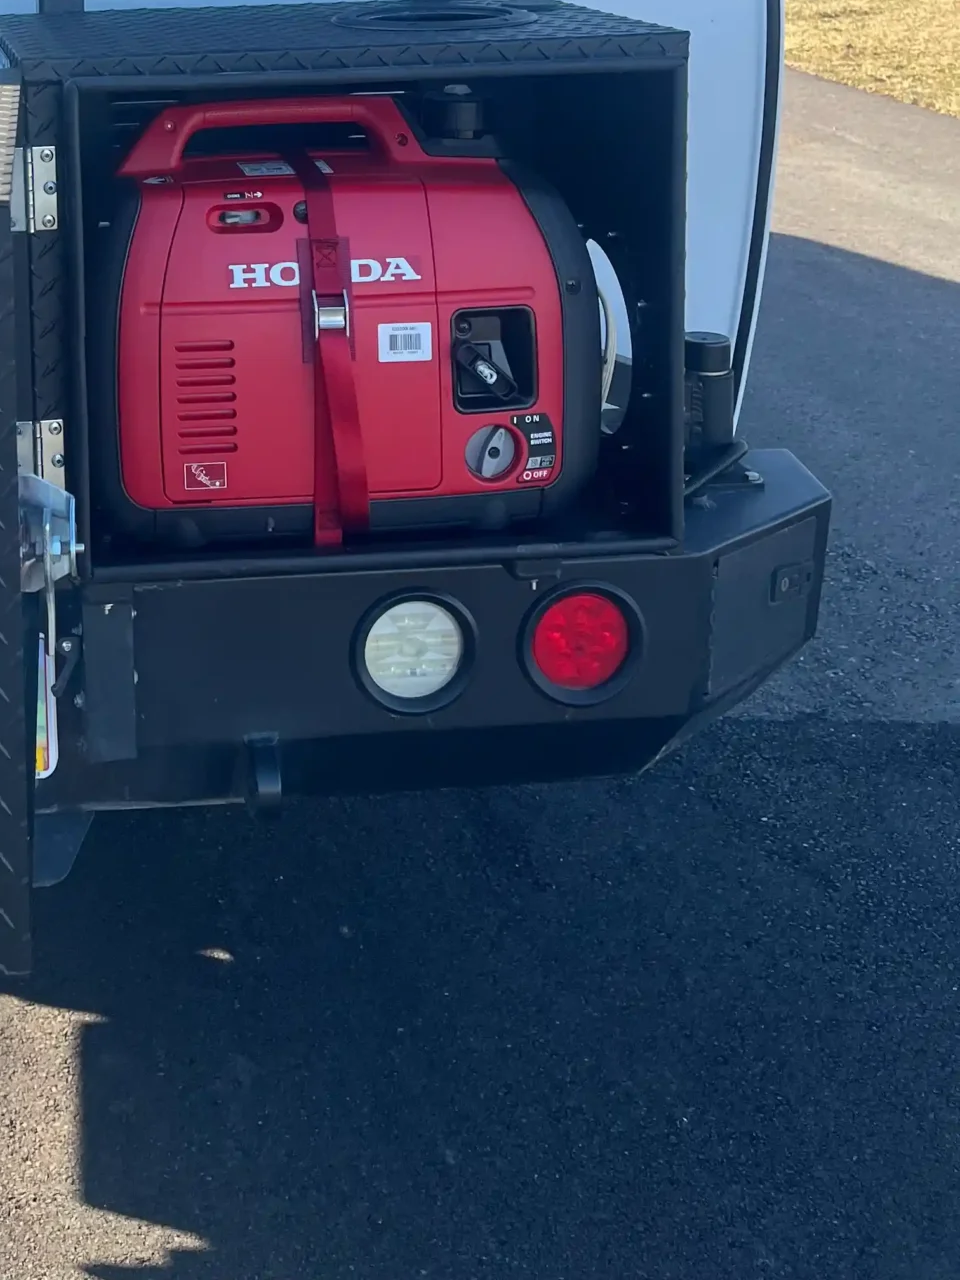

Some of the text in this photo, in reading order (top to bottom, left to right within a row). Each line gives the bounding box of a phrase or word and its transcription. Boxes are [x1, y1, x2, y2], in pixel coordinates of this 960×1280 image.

[228, 257, 422, 289] HODA
[525, 415, 540, 423] ON
[533, 470, 547, 478] OFF
